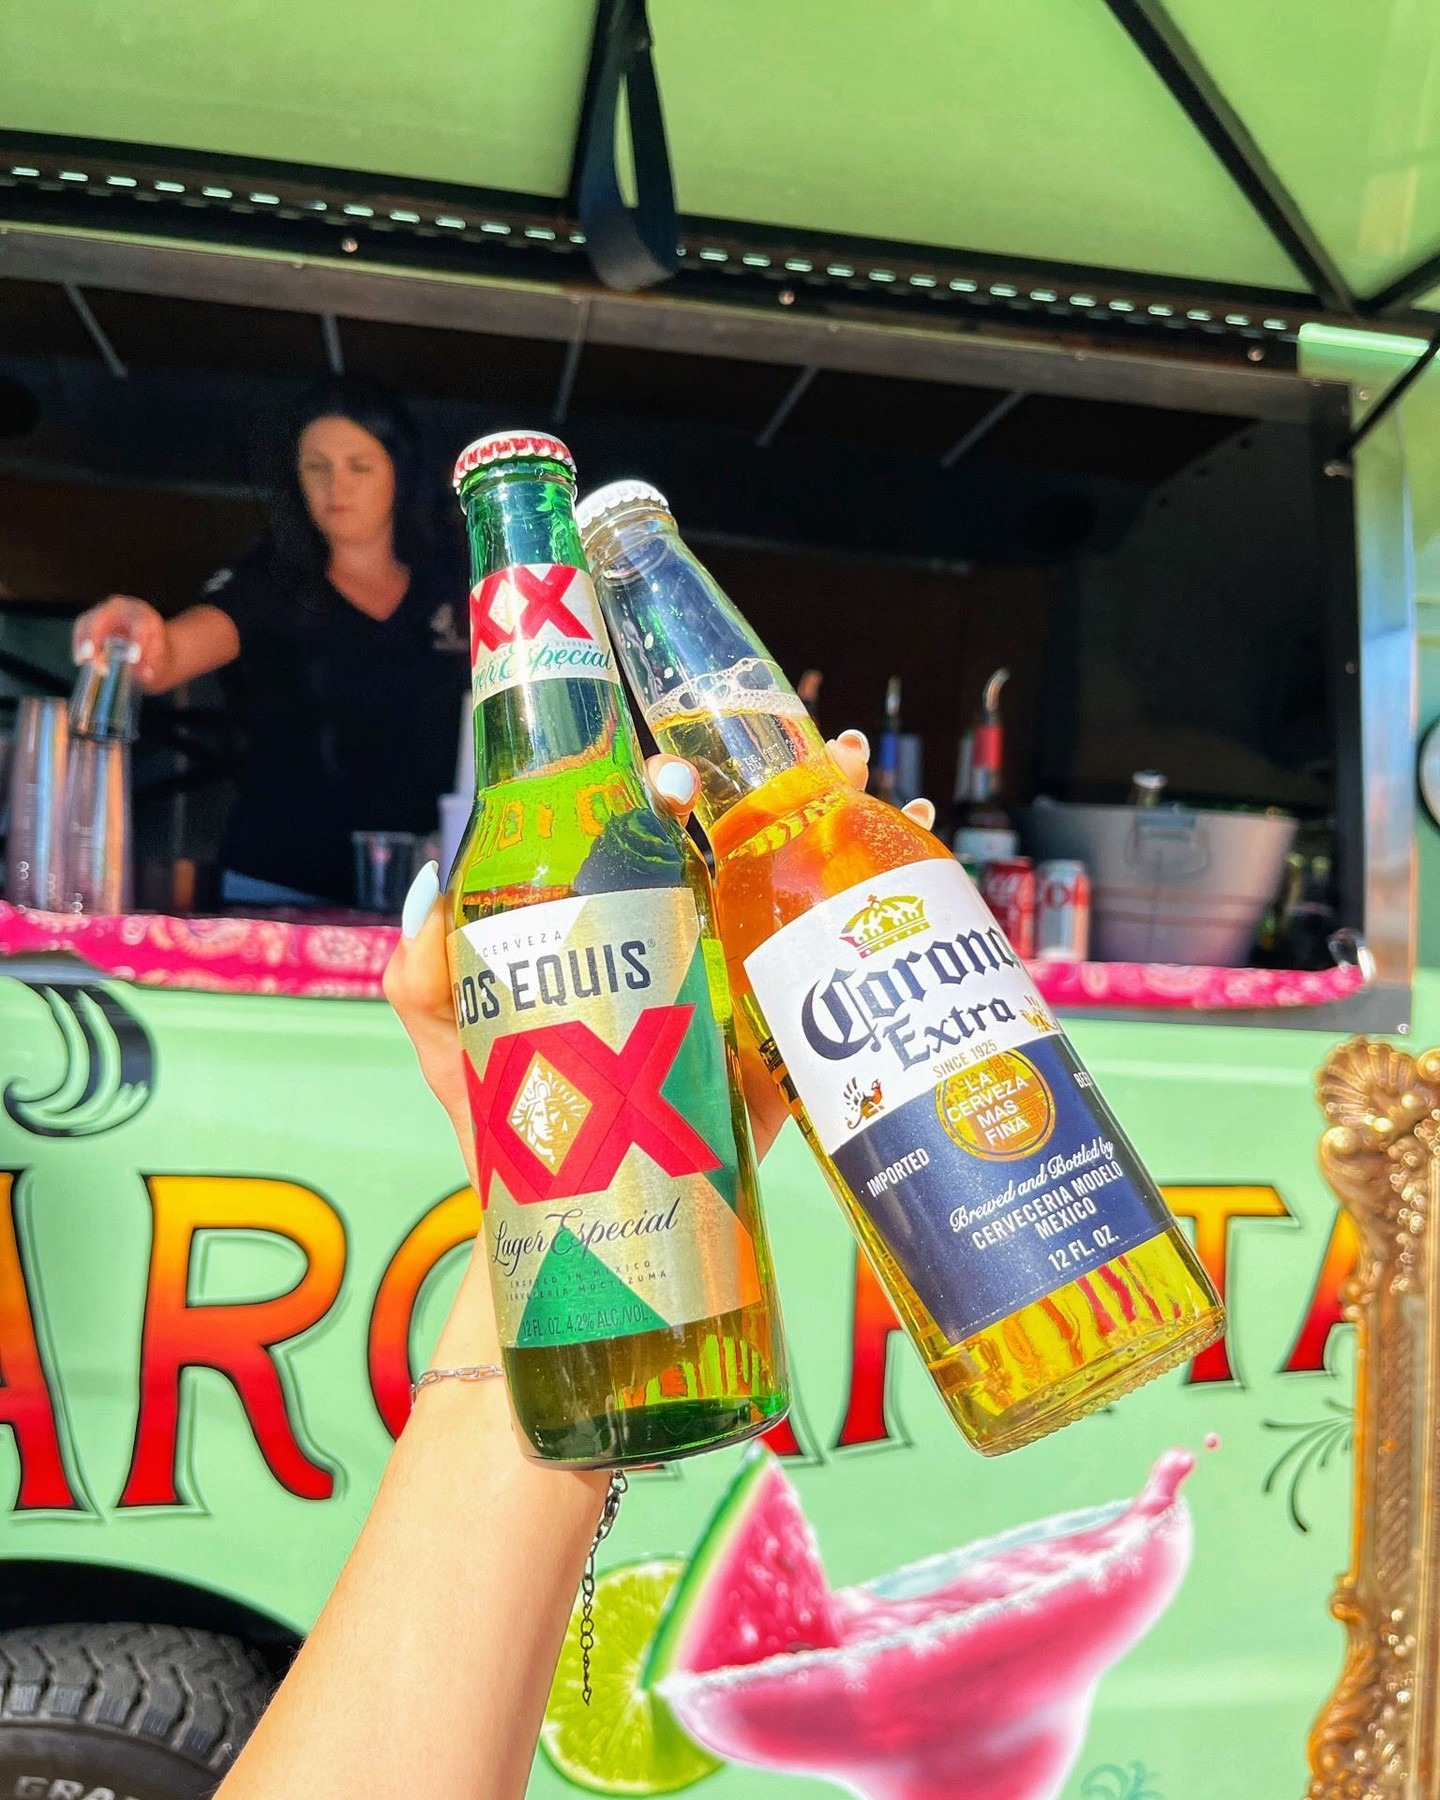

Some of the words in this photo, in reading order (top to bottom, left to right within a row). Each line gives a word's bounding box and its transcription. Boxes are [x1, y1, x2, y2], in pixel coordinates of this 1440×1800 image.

[482, 930, 562, 958] CERVEZA
[507, 940, 652, 1012] EQUIS
[802, 926, 1021, 1061] Corona
[882, 997, 1017, 1071] Extra
[933, 1052, 970, 1079] SINCE
[970, 1039, 998, 1060] 1925
[1073, 1071, 1094, 1088] BEE
[946, 1075, 1030, 1122] CERVEZA
[964, 1072, 993, 1093] LA
[462, 1004, 723, 1211] XX
[976, 1099, 1019, 1129] MAS
[984, 1116, 1031, 1146] FINA
[866, 1147, 931, 1198] IMPORTED
[949, 1179, 1017, 1233] Brewed
[1017, 1163, 1048, 1196] and
[1047, 1139, 1104, 1180] Bottled
[1099, 1135, 1114, 1160] by
[971, 1185, 1074, 1250] CERVECERIA
[1073, 1160, 1124, 1195] MODELO
[1034, 1197, 1098, 1240] MEXICO
[492, 1220, 549, 1277] Lager
[545, 1196, 681, 1260] Especial
[1047, 1249, 1072, 1272] 12
[1070, 1237, 1097, 1261] FL.
[1091, 1224, 1121, 1247] OZ.
[567, 1273, 582, 1282] IN
[593, 1260, 652, 1276] MEXICO
[578, 1270, 668, 1293] MOCTEZUMA
[566, 1311, 595, 1334] 4.2%
